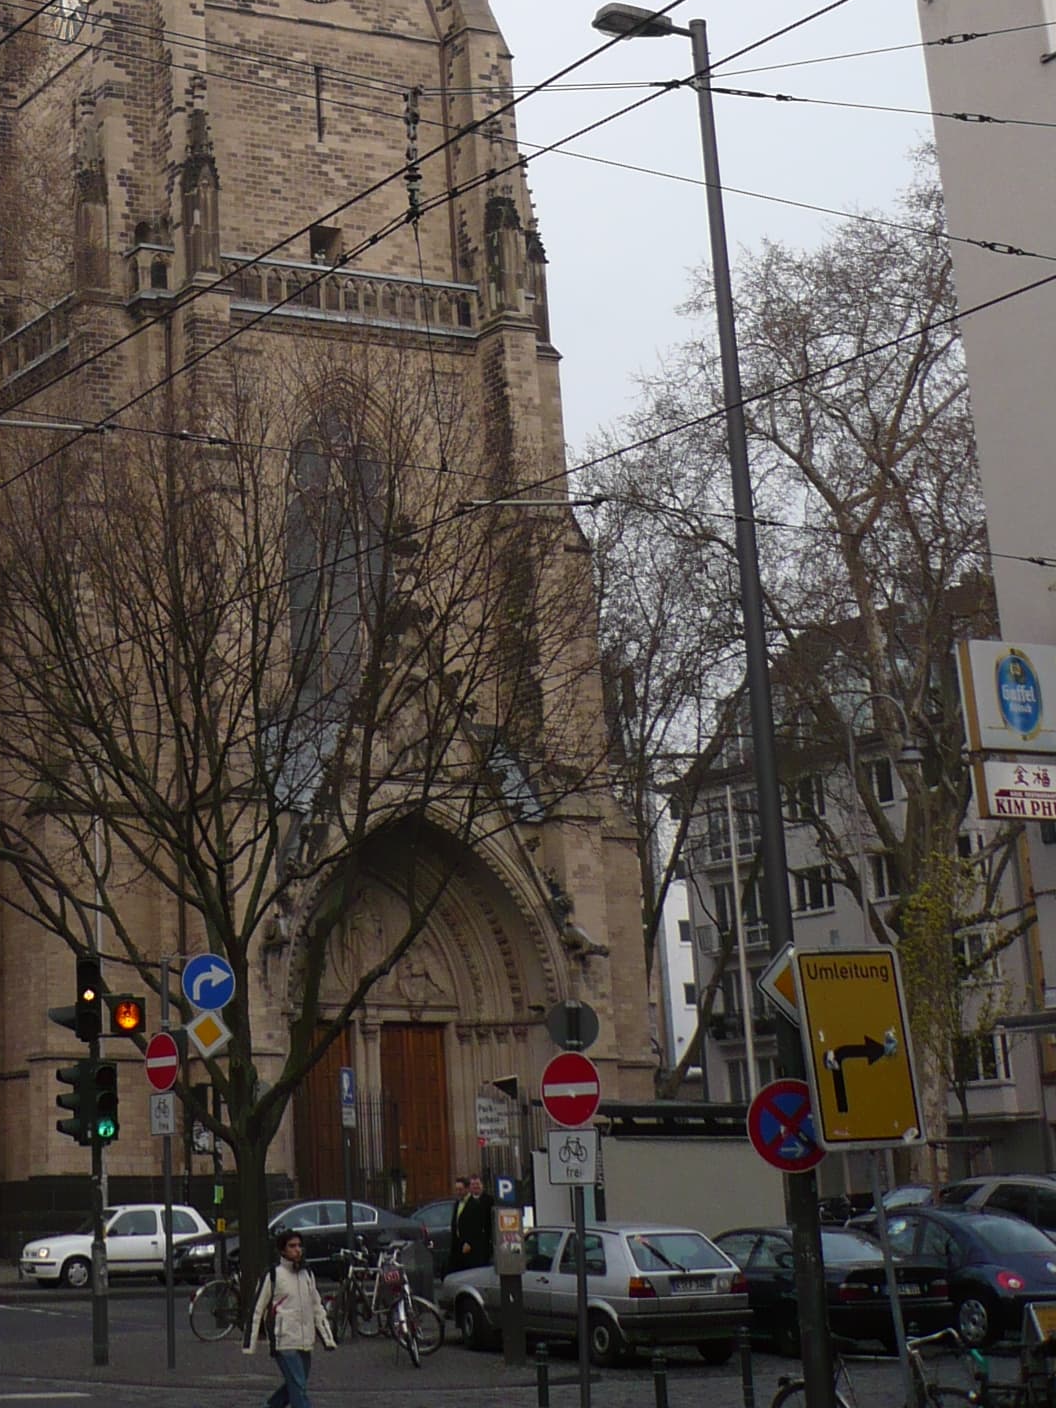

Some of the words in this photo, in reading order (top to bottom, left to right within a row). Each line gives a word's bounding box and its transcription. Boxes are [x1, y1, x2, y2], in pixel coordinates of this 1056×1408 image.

[995, 798, 1027, 815] KIM
[1031, 800, 1056, 817] PH
[806, 961, 889, 983] Umleitung
[498, 1179, 513, 1200] P
